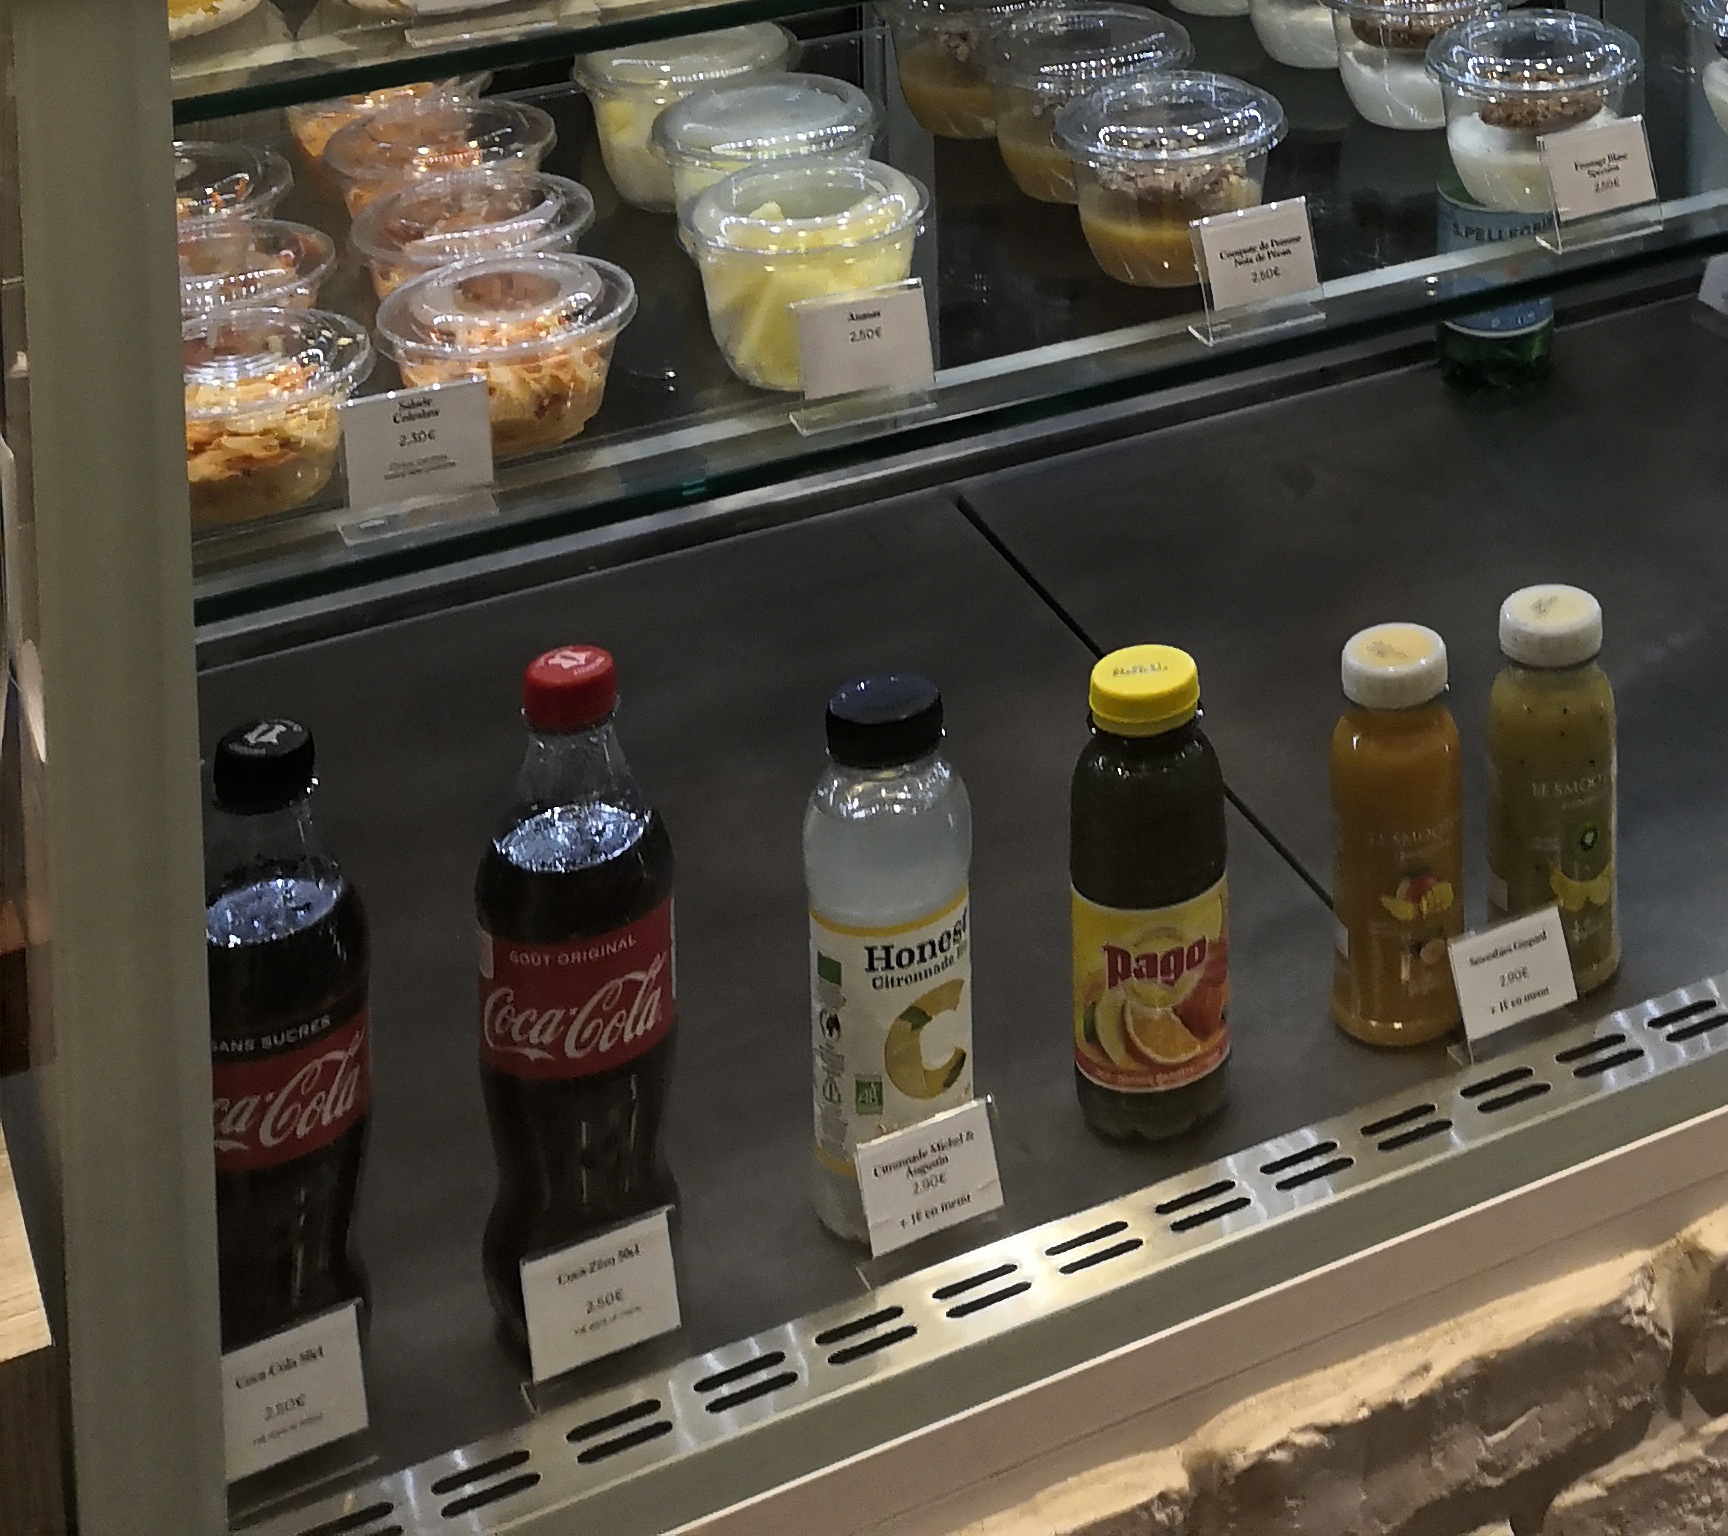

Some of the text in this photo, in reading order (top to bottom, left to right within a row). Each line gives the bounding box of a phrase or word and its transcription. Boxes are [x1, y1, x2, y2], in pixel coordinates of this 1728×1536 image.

[556, 933, 638, 968] ORIGINAL
[483, 950, 669, 1064] Coca-Cola
[261, 1015, 332, 1051] SUCRES
